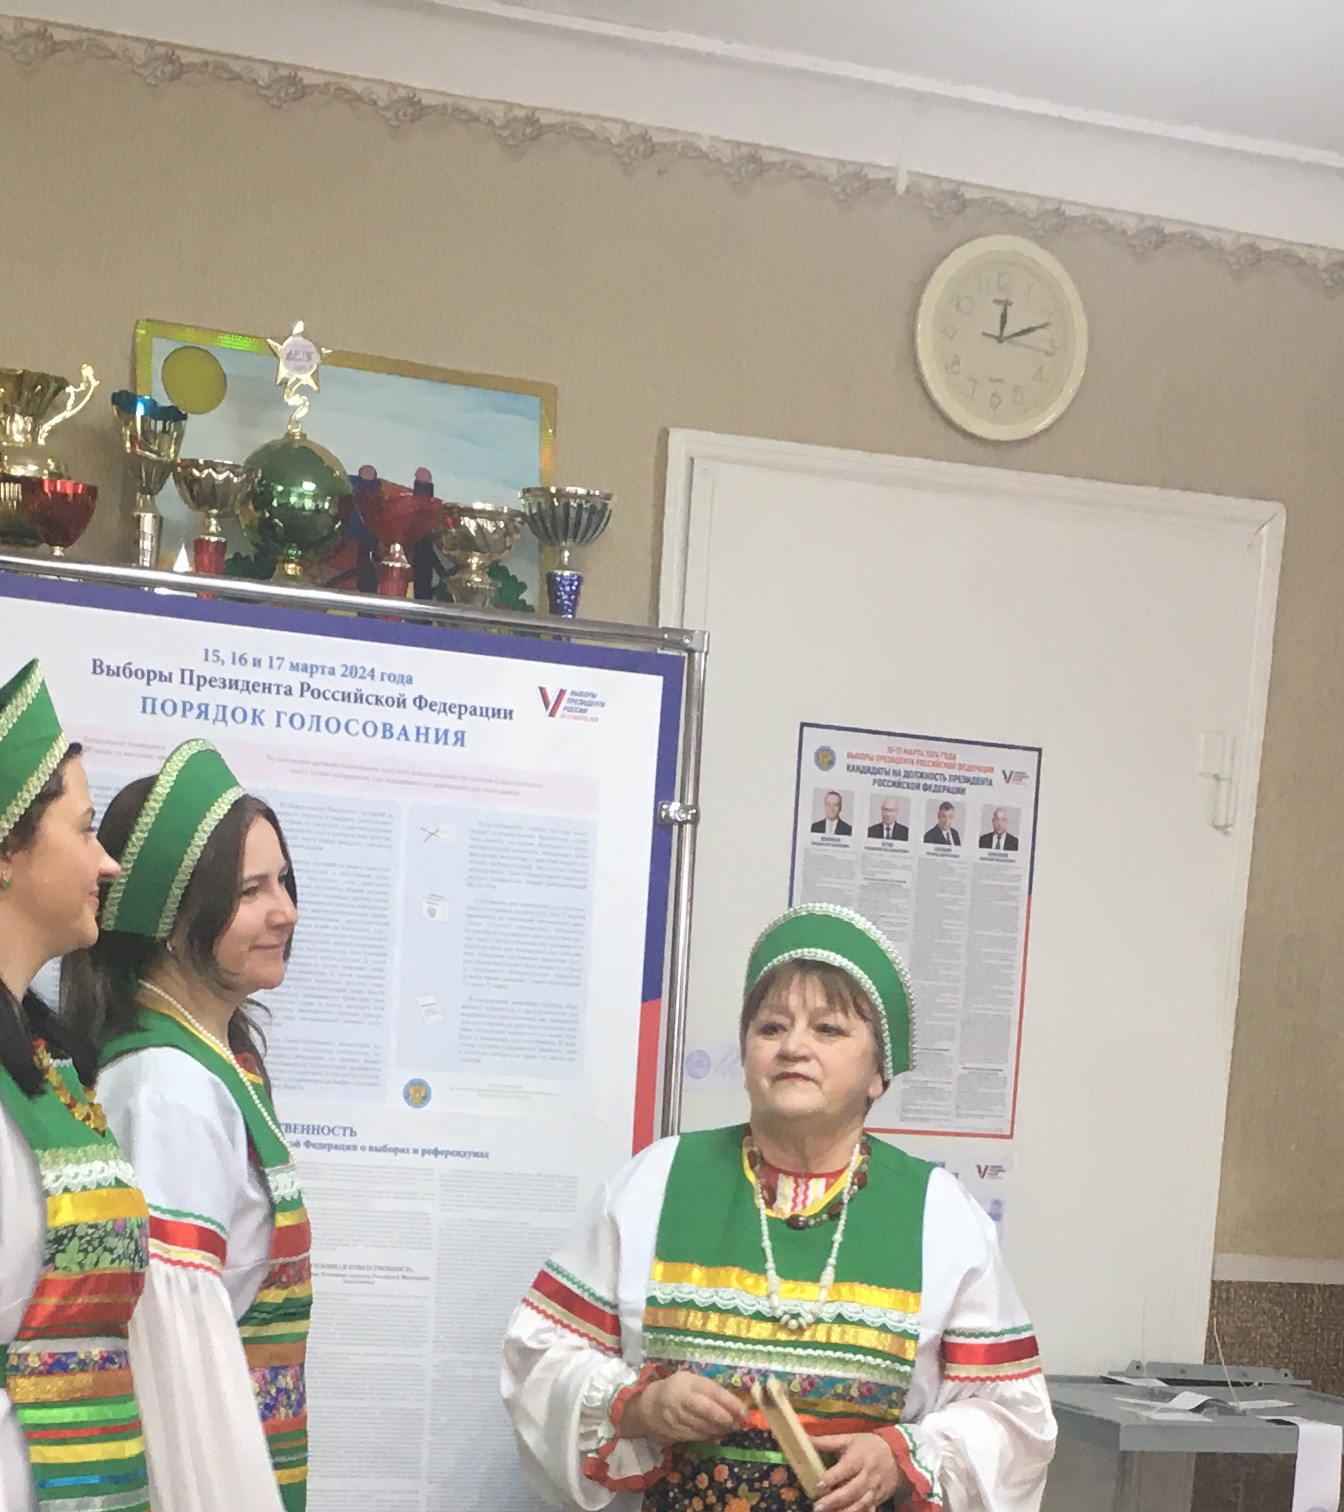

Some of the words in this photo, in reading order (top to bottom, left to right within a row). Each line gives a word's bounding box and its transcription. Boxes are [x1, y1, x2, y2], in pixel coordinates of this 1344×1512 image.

[91, 657, 173, 686] Выборы
[179, 668, 294, 698] Президента
[299, 681, 407, 710] Российской
[412, 694, 514, 721] Федерации
[203, 648, 225, 666] 15,
[230, 651, 248, 667] 16
[252, 657, 262, 669] и
[268, 655, 285, 671] 17
[289, 660, 336, 679] марта
[340, 663, 376, 681] 2024
[380, 671, 413, 686] года
[140, 695, 266, 727] ПОРЯДОК
[274, 711, 467, 748] ГОЛОСОВАНИЯ
[303, 1139, 358, 1152] Федерации
